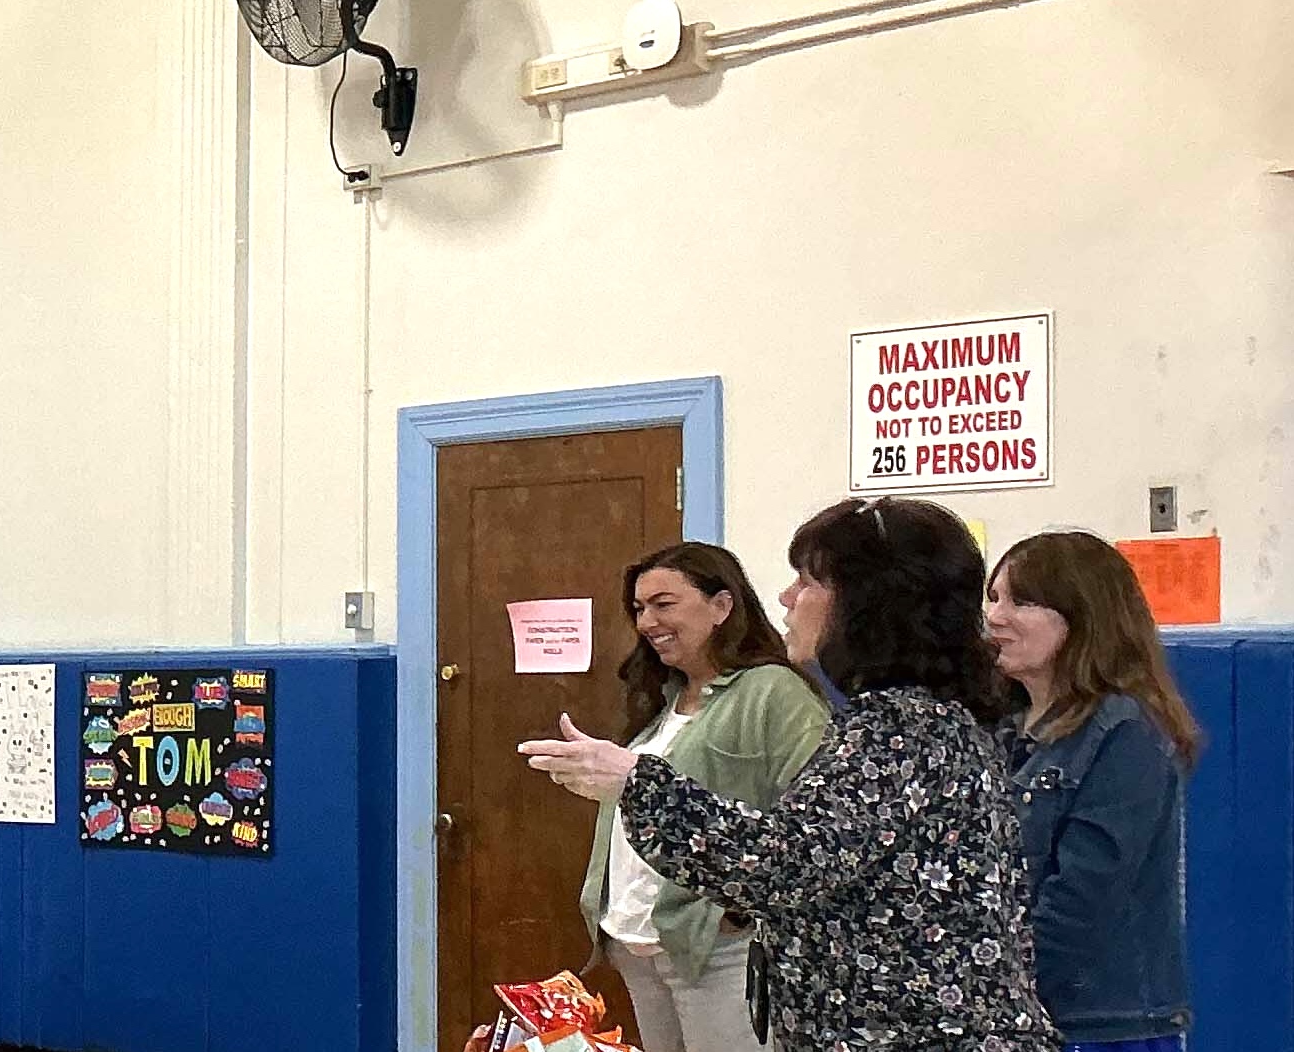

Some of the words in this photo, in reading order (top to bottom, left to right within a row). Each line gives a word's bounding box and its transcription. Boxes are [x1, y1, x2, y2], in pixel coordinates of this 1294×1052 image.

[878, 331, 1021, 375] MAXIMUM
[867, 369, 1031, 414] OCCUPANCY
[876, 418, 913, 440] NOT
[918, 416, 942, 437] TO
[948, 409, 1023, 435] EXCEED
[872, 444, 907, 475] 256
[916, 437, 1037, 476] PERSONS
[132, 735, 212, 787] TOM
[232, 821, 259, 844] KIND
